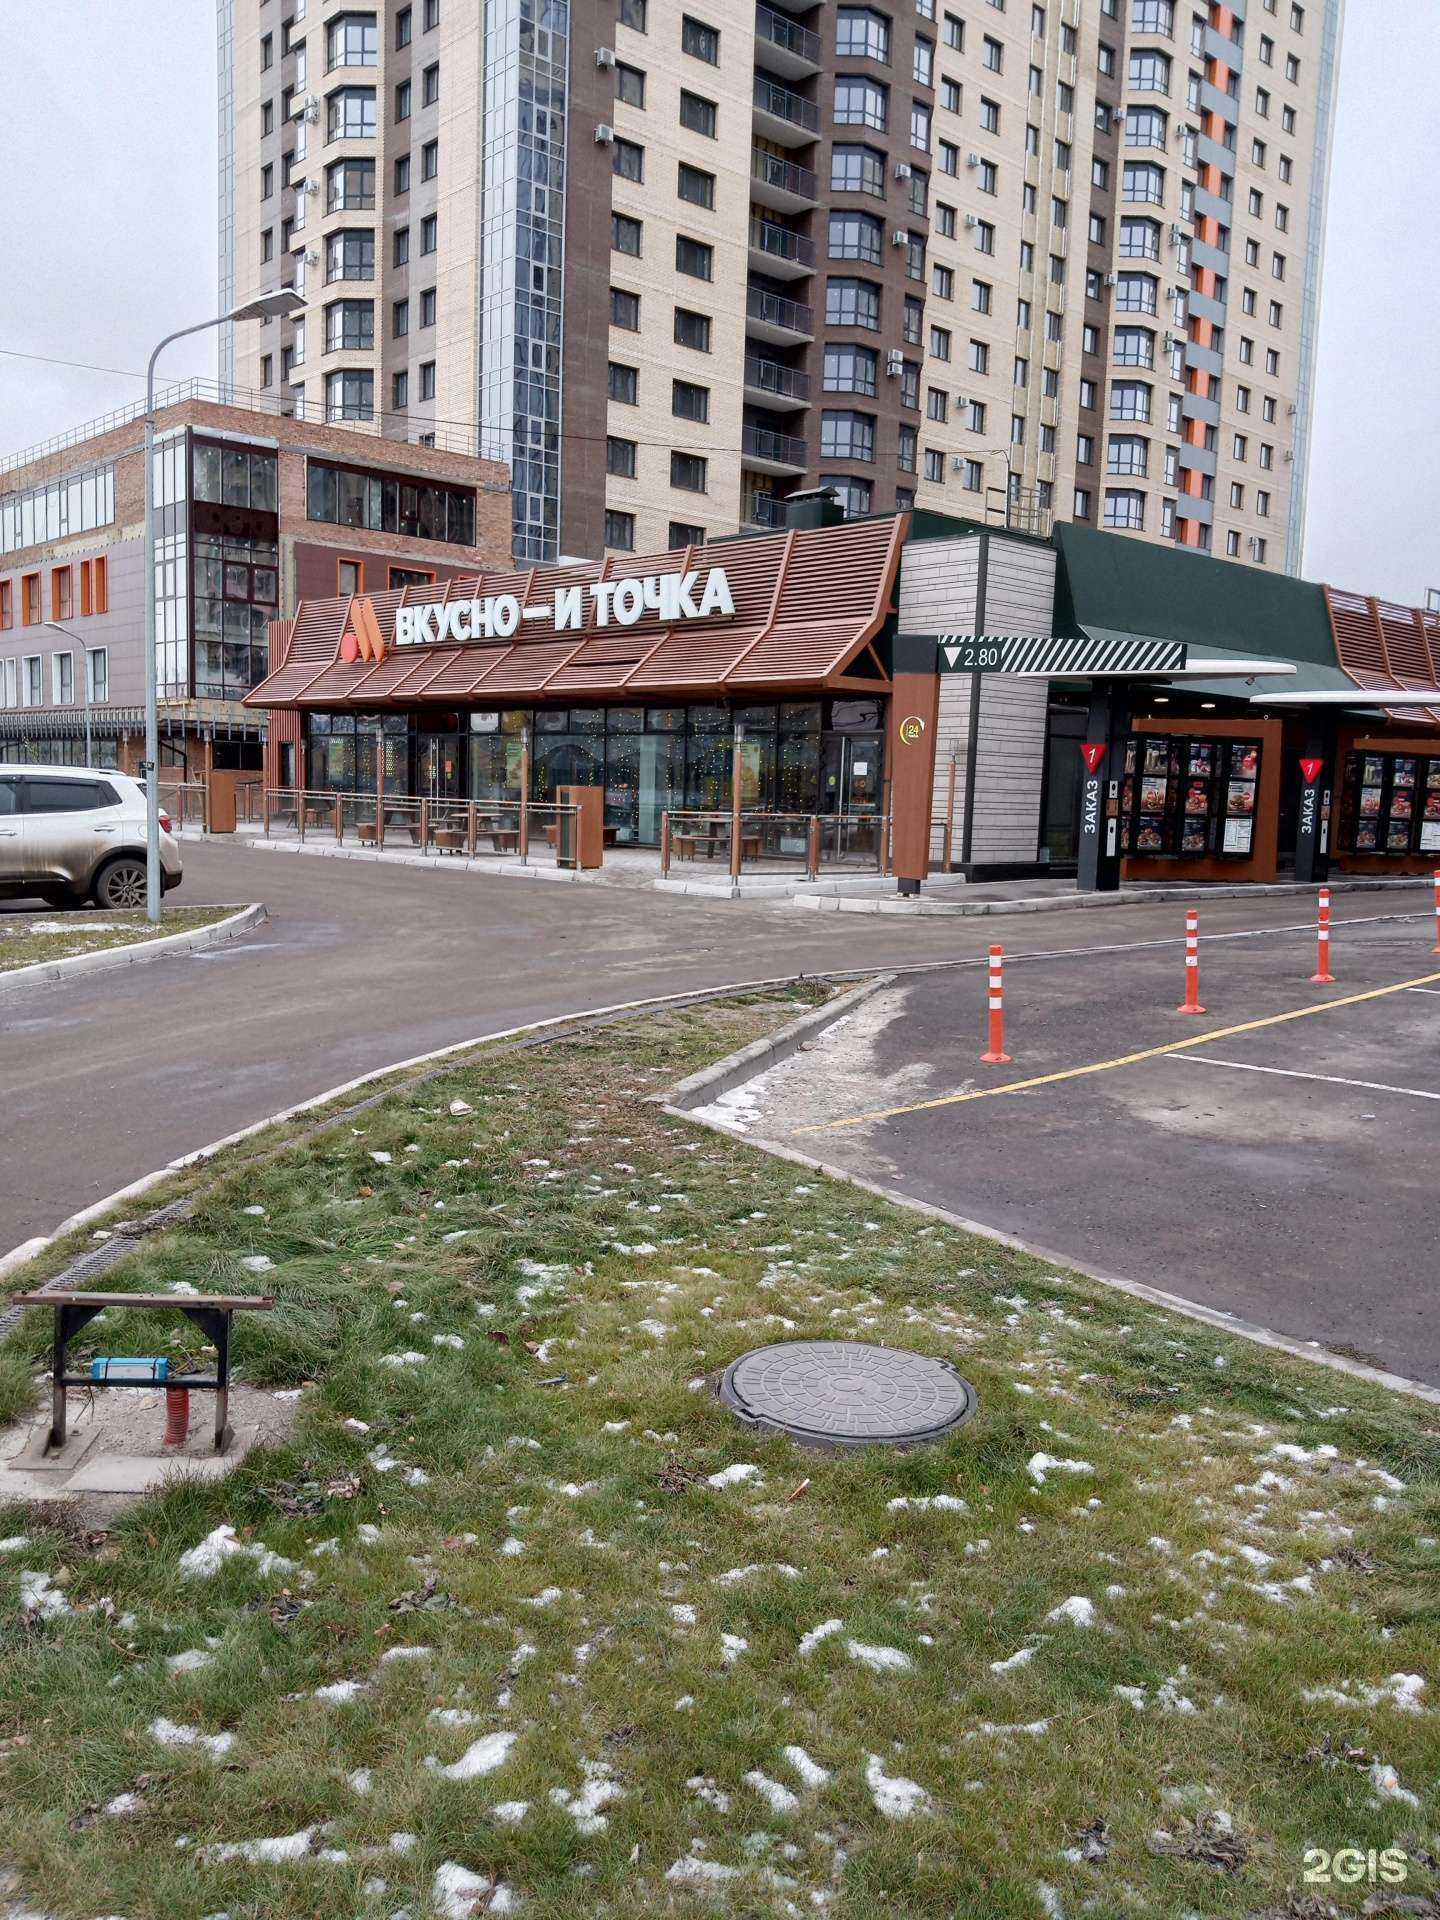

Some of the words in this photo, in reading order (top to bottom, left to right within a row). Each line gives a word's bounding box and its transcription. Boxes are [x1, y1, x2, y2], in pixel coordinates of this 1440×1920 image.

[396, 594, 520, 645] ВКУСНО
[554, 586, 583, 631] И
[590, 567, 736, 627] ТОЧКА
[963, 648, 998, 667] 2.80
[908, 724, 919, 735] 24
[1089, 748, 1096, 763] 1
[1084, 780, 1098, 834] ЗАКАЗ
[1301, 789, 1315, 834] ЗАКАЗ
